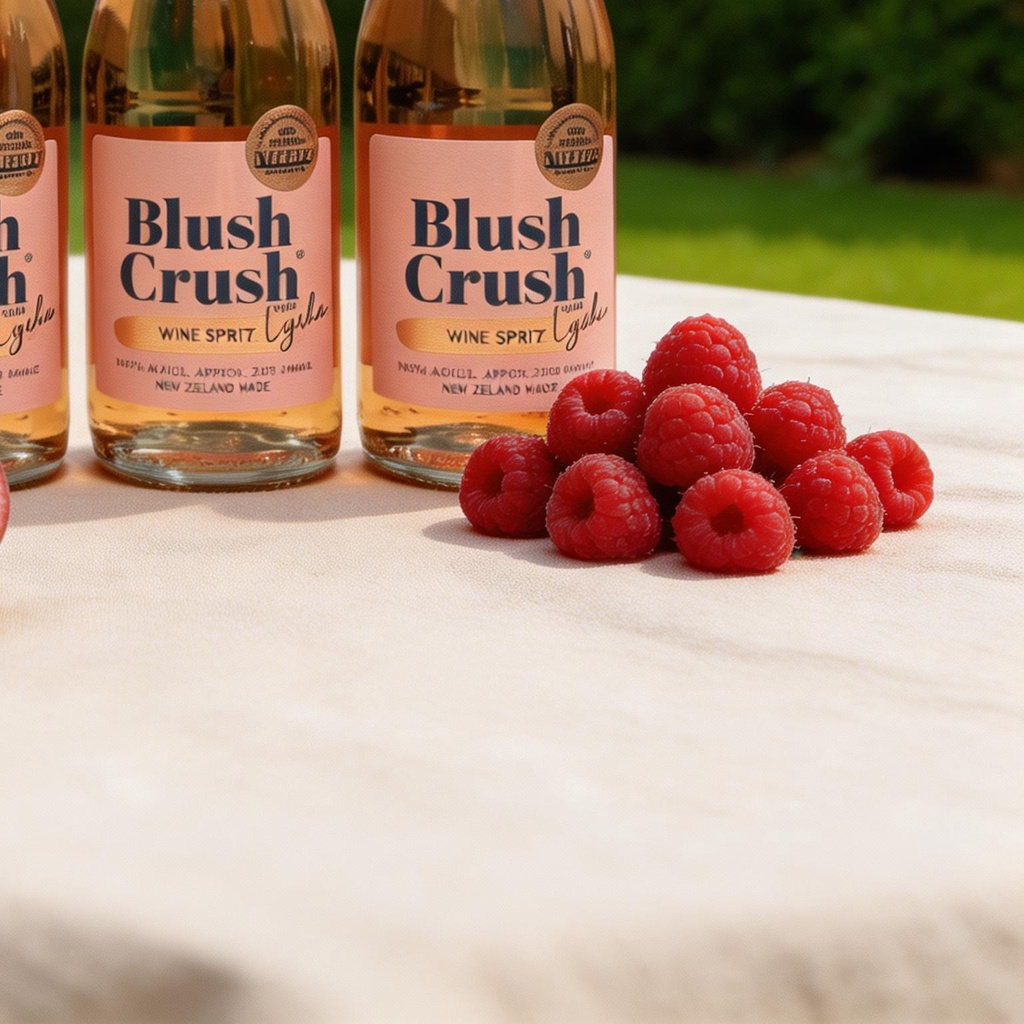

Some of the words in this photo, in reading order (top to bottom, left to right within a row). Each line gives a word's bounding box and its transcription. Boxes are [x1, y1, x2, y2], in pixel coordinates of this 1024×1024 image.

[124, 195, 292, 251] Blush
[411, 196, 581, 251] Blush
[120, 250, 299, 305] Crush
[404, 251, 586, 306] Crush
[158, 326, 201, 342] WINE
[446, 328, 490, 344] WINE
